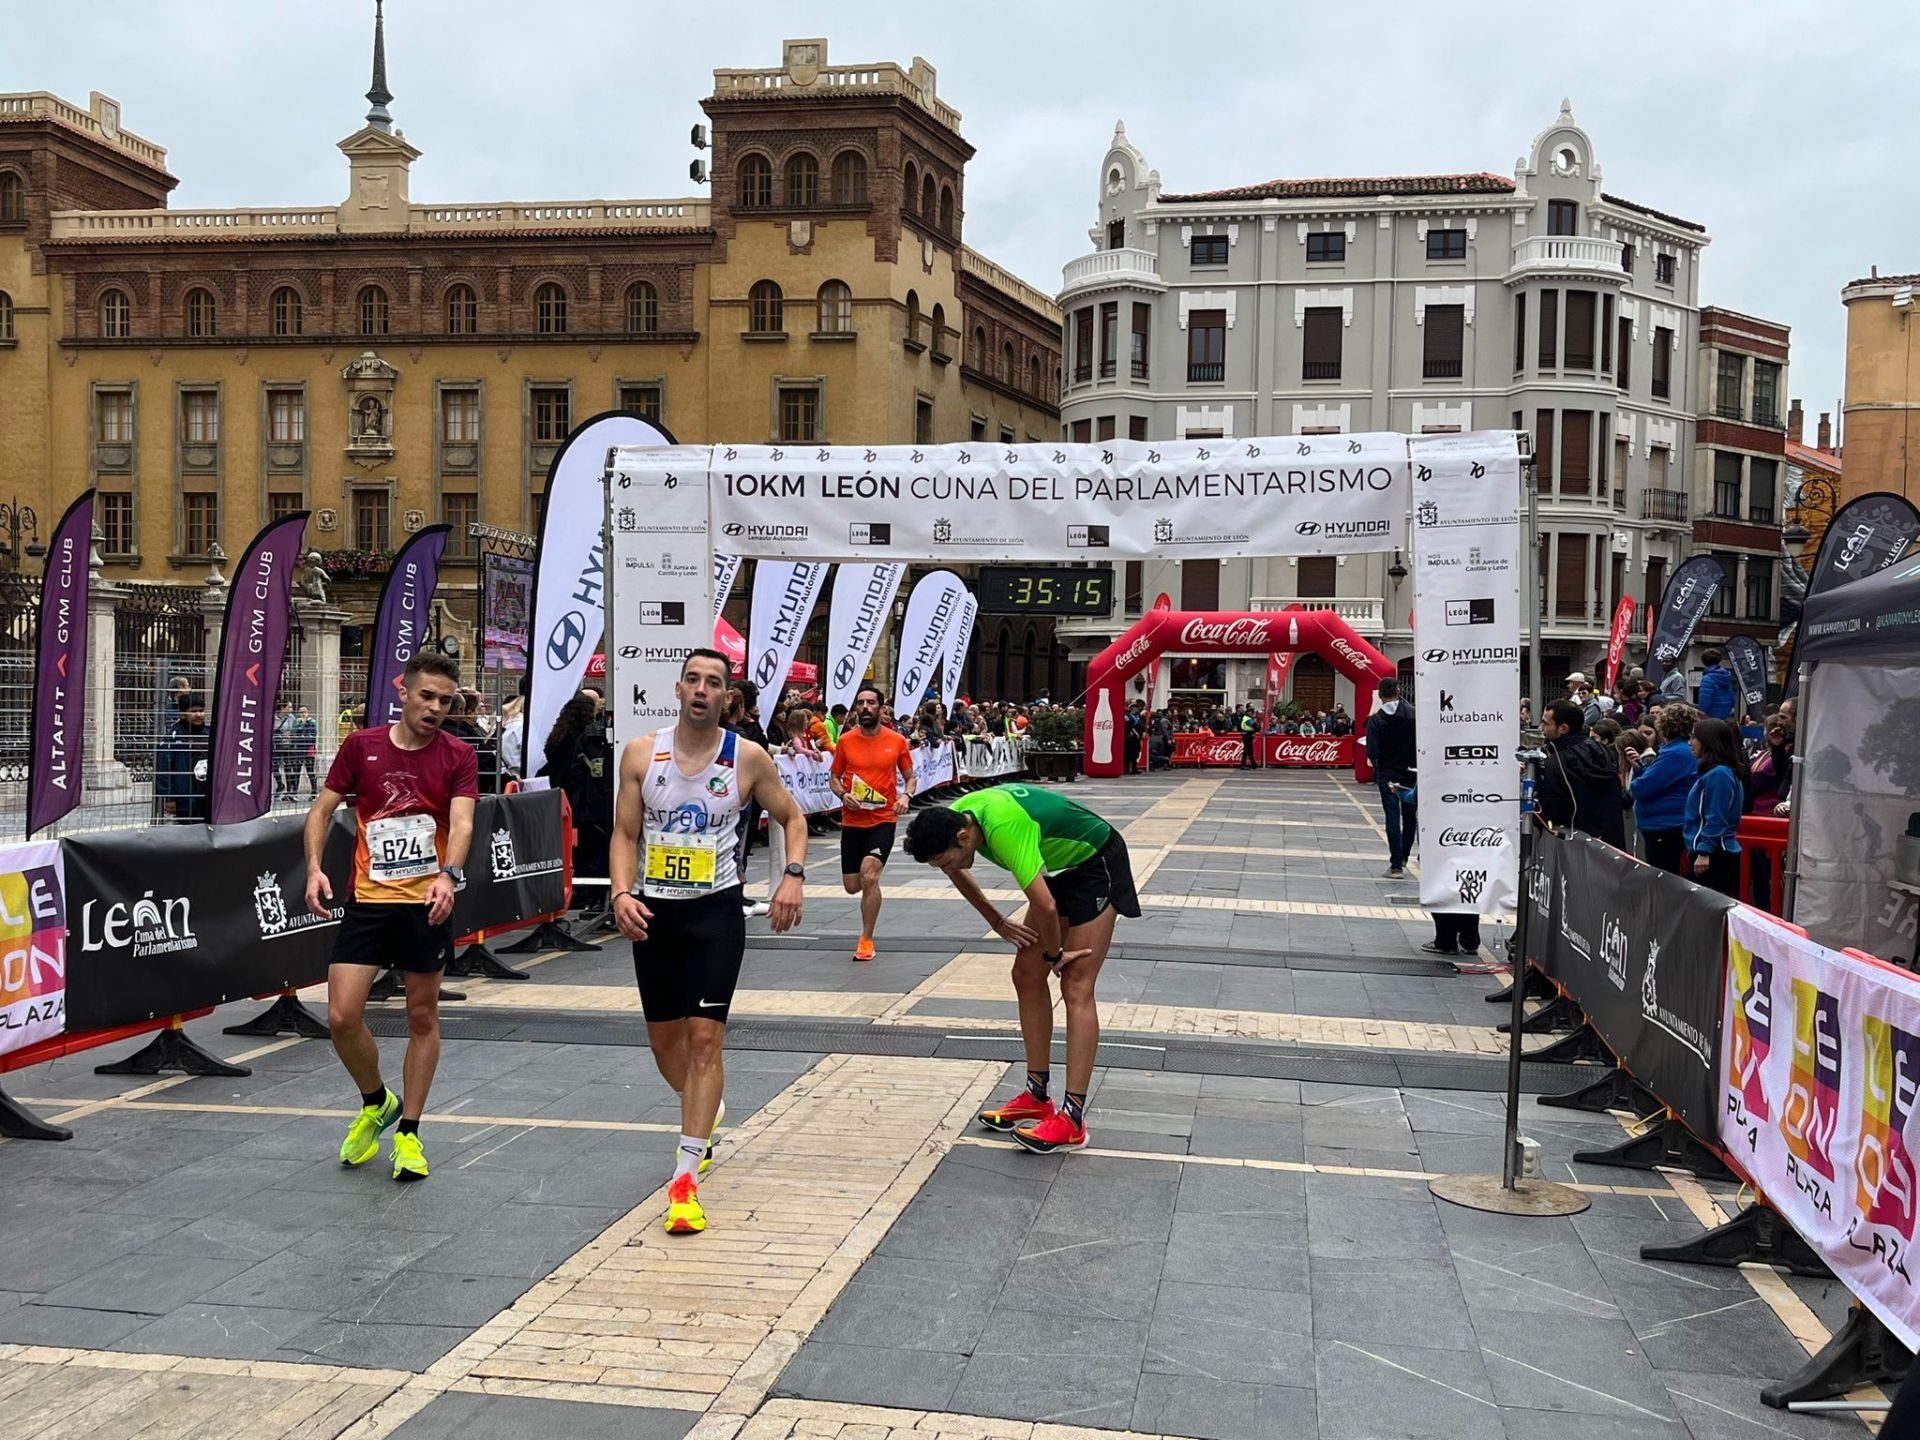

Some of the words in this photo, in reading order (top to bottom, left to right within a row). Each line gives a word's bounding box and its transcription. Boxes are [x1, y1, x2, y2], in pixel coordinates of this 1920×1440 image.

[723, 474, 805, 498] 10KM
[822, 470, 900, 499] LEÓN
[910, 476, 998, 500] CUNA
[1009, 477, 1064, 500] DEL
[1075, 467, 1392, 501] PARLAMENTARISMO
[748, 525, 808, 537] HYUNDAI
[1325, 520, 1390, 533] HYUNDAI
[61, 537, 74, 588] CLUB
[1881, 556, 1891, 569] DE
[1888, 536, 1906, 561] LEÓN
[255, 550, 274, 600] CLUB
[58, 599, 70, 644] GYM
[862, 616, 880, 654] Lemauto
[876, 562, 899, 616] Automoción
[1448, 608, 1469, 616] LEÓN
[249, 610, 265, 654] GYM
[396, 620, 414, 662] GYM
[784, 605, 804, 648] Lemauto
[915, 587, 957, 665] HYUNDAI
[952, 601, 973, 666] HYUNDAI
[1181, 618, 1273, 646] Coca-Cola
[646, 648, 694, 658] HYUND
[926, 637, 944, 667] Lemauto
[1452, 648, 1518, 660] HYUNDAI
[633, 707, 681, 717] kutxaba
[1440, 712, 1504, 724] kutxabank
[52, 687, 67, 790] ALTAFIT
[236, 694, 257, 796] ALTAFIT
[1275, 740, 1342, 762] Coca-Cola
[1447, 748, 1498, 758] LEON
[383, 836, 423, 862] 624
[396, 866, 429, 874] HYUNDAI
[665, 856, 690, 880] 56
[133, 937, 198, 958] Parlamentarismo
[134, 930, 153, 944] Cuna
[154, 926, 167, 941] del
[1659, 1006, 1698, 1044] AYUNTAMIENTO
[1794, 996, 1837, 1072] LE
[1784, 1083, 1835, 1163] ON
[1786, 1152, 1832, 1221] PLAZA
[1841, 1216, 1911, 1286] PLAZA
